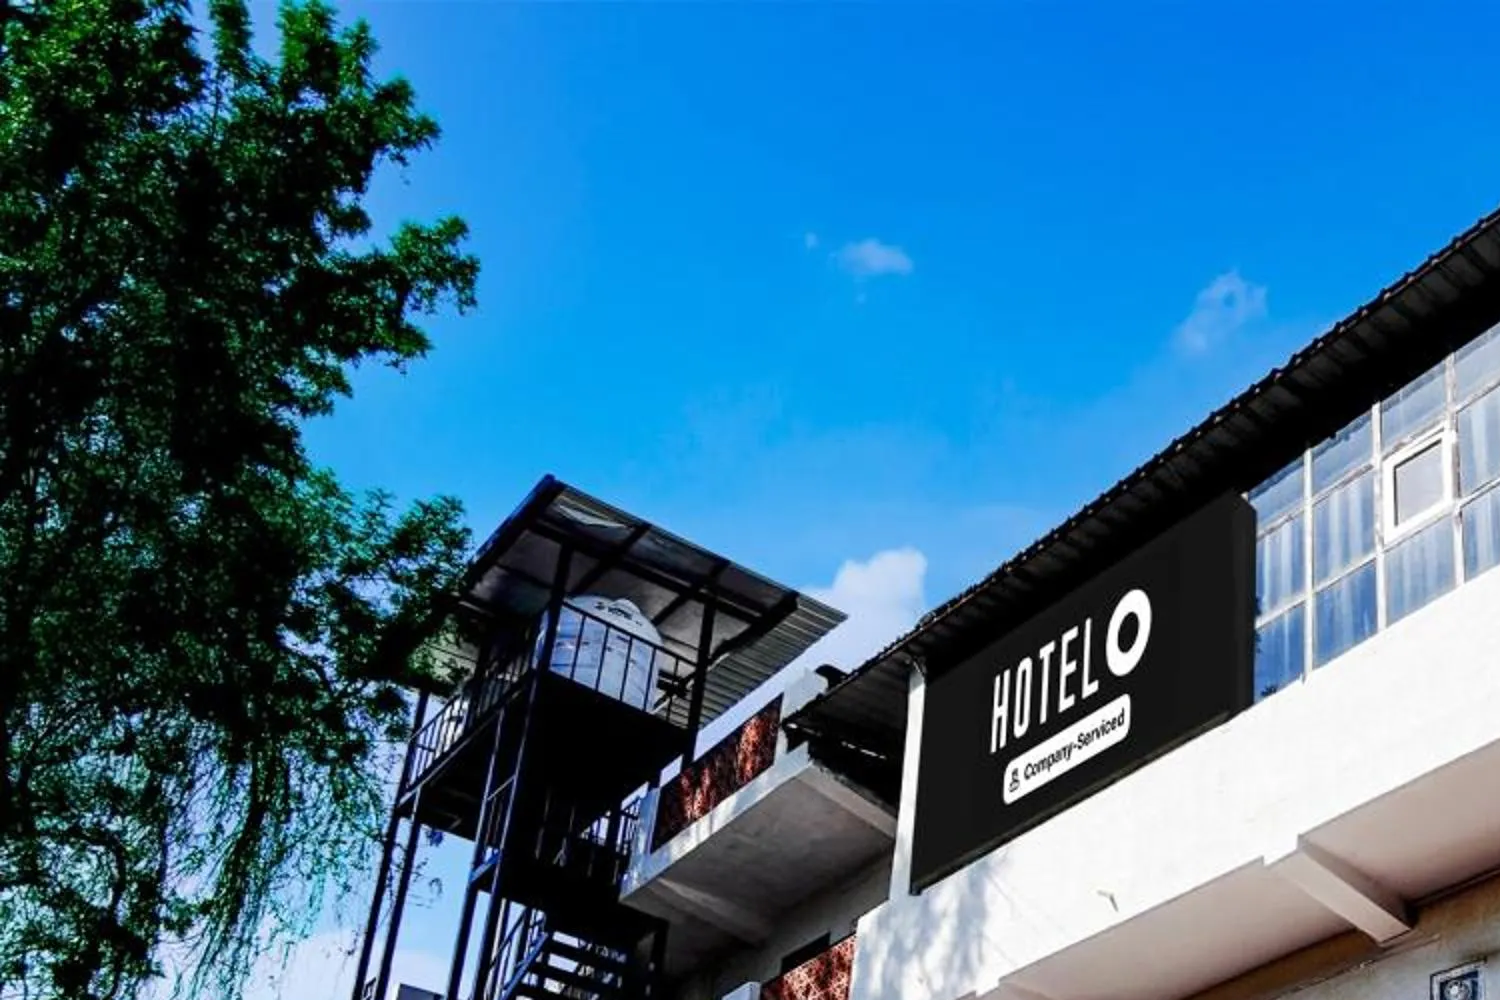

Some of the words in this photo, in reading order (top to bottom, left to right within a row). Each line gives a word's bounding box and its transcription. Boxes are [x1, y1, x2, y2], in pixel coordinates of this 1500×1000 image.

[990, 617, 1099, 754] HOTEL
[1106, 589, 1152, 677] O
[1023, 706, 1126, 781] Company-Serviced
